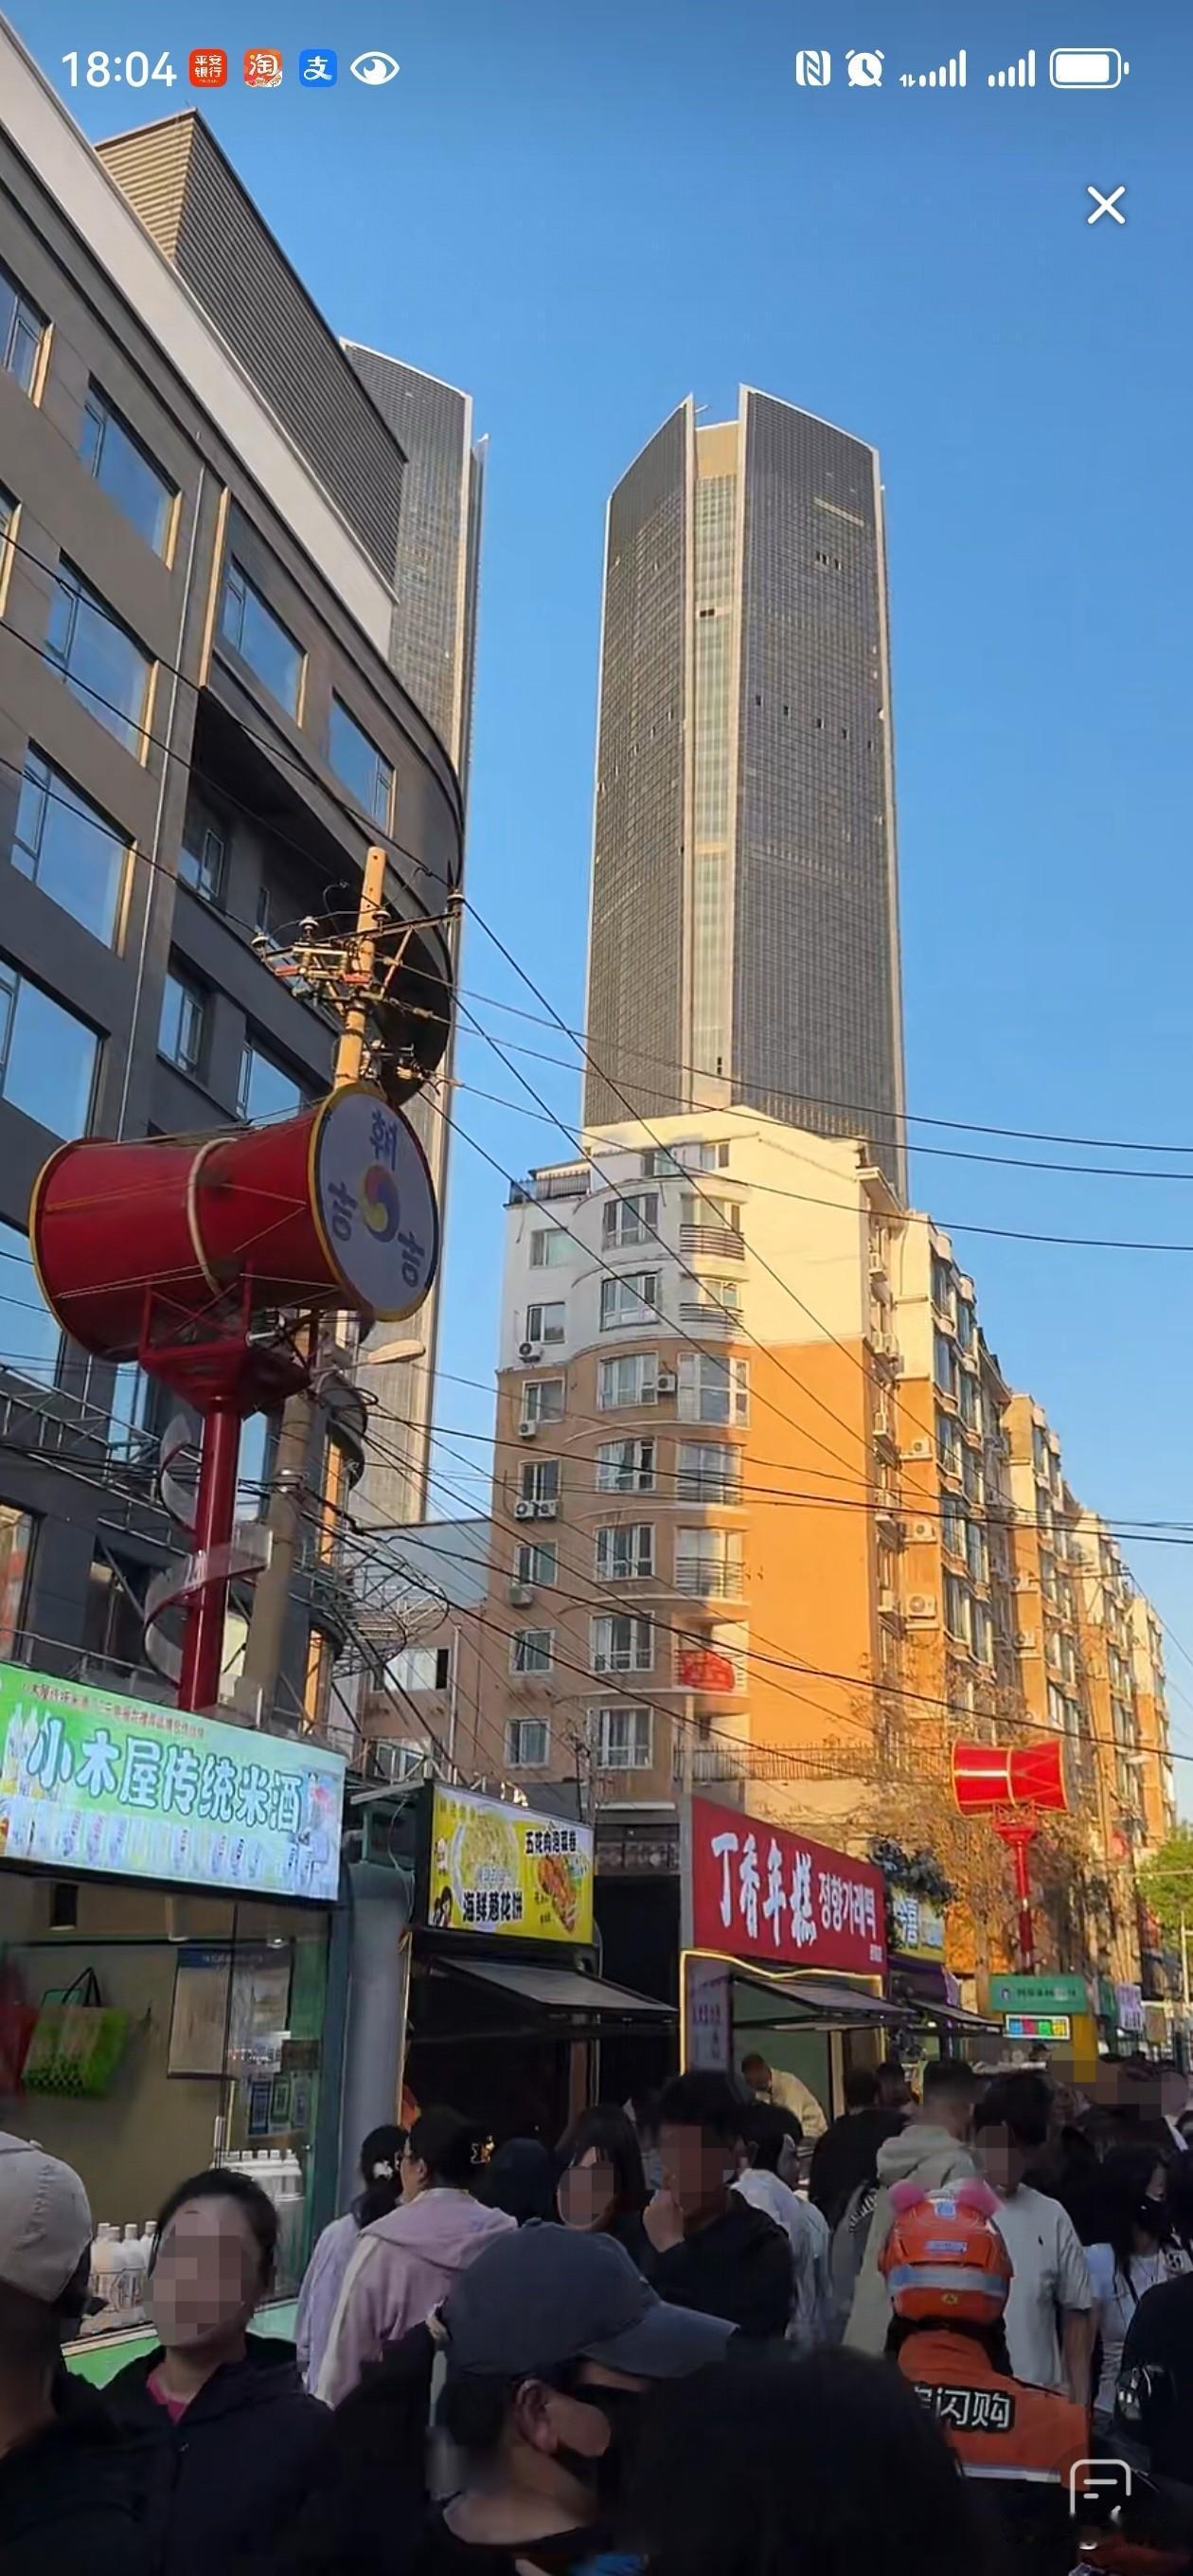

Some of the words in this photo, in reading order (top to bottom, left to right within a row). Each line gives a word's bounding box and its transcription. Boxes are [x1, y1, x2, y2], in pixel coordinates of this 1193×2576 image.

[27, 1717, 303, 1834] 小木屋传统米酒
[463, 1890, 523, 1923] 海鲜葱花饼
[711, 1832, 817, 1948] 丁香年糕
[818, 1871, 877, 1941] 정향가래떡
